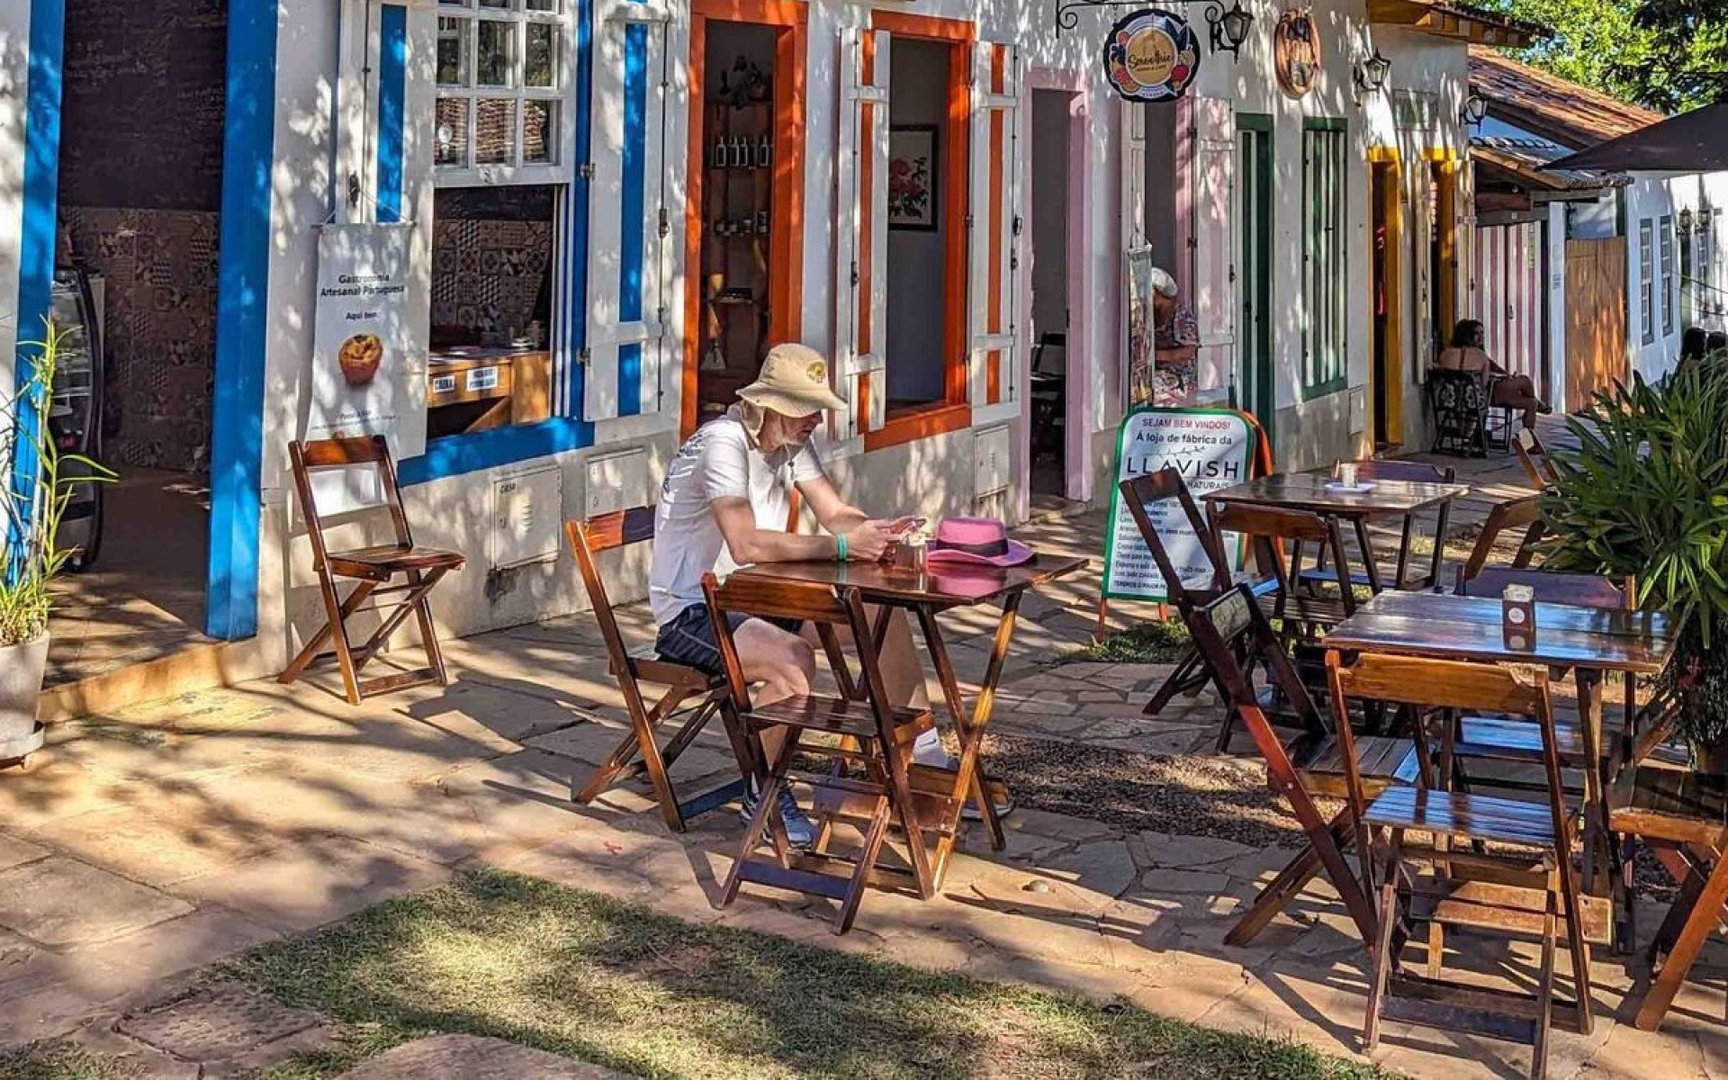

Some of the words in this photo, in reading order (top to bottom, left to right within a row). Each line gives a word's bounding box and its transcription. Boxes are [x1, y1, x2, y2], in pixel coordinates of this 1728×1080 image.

[1142, 418, 1171, 428] SEJAM
[1174, 419, 1193, 428] BEM
[1195, 420, 1230, 430] VINDOS!
[1146, 433, 1164, 444] loja
[1167, 434, 1179, 443] de
[1182, 434, 1217, 445] fábrica
[1219, 435, 1232, 445] da
[1127, 457, 1239, 479] LLAVISH
